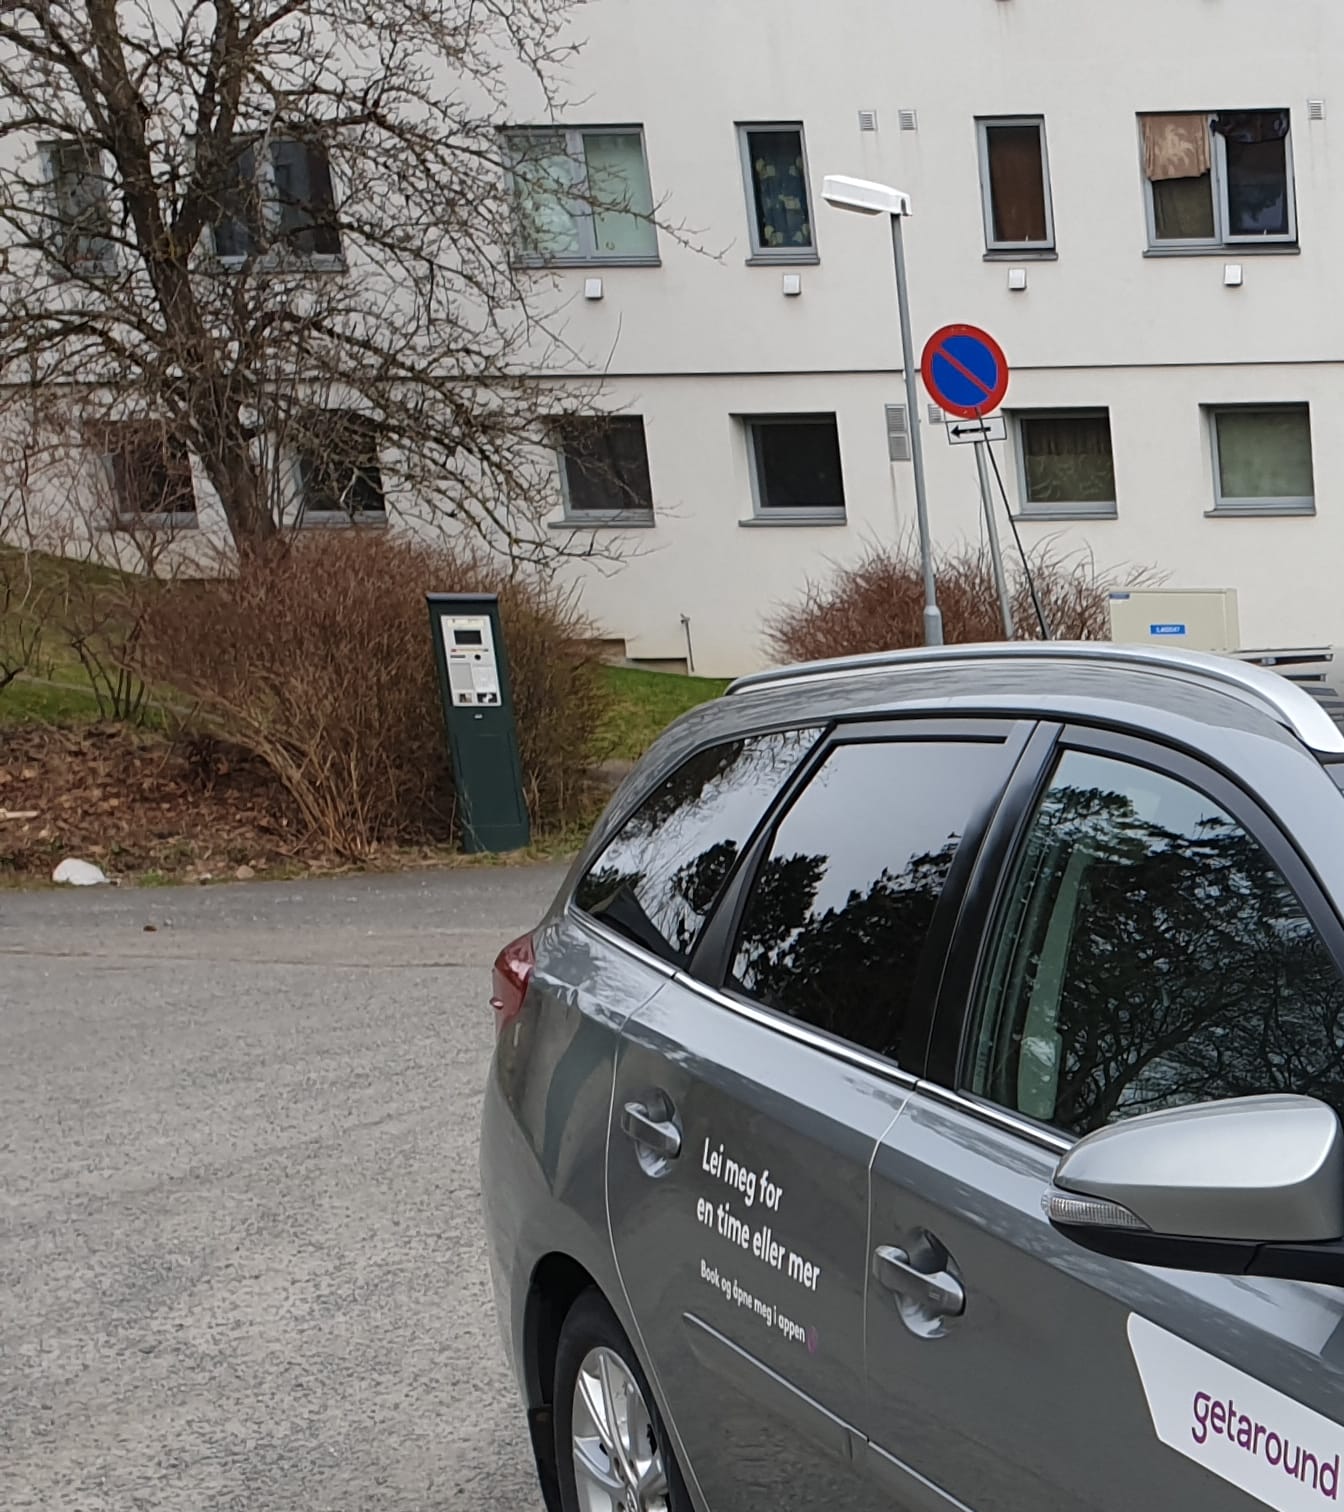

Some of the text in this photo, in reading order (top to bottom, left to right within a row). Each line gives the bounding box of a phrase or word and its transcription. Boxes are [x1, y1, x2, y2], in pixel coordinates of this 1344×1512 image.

[702, 1137, 783, 1211] Lei meg for
[697, 1197, 820, 1290] en time eller mer
[700, 1259, 806, 1344] Book og åpne meg i appen
[1191, 1391, 1340, 1500] getaround
